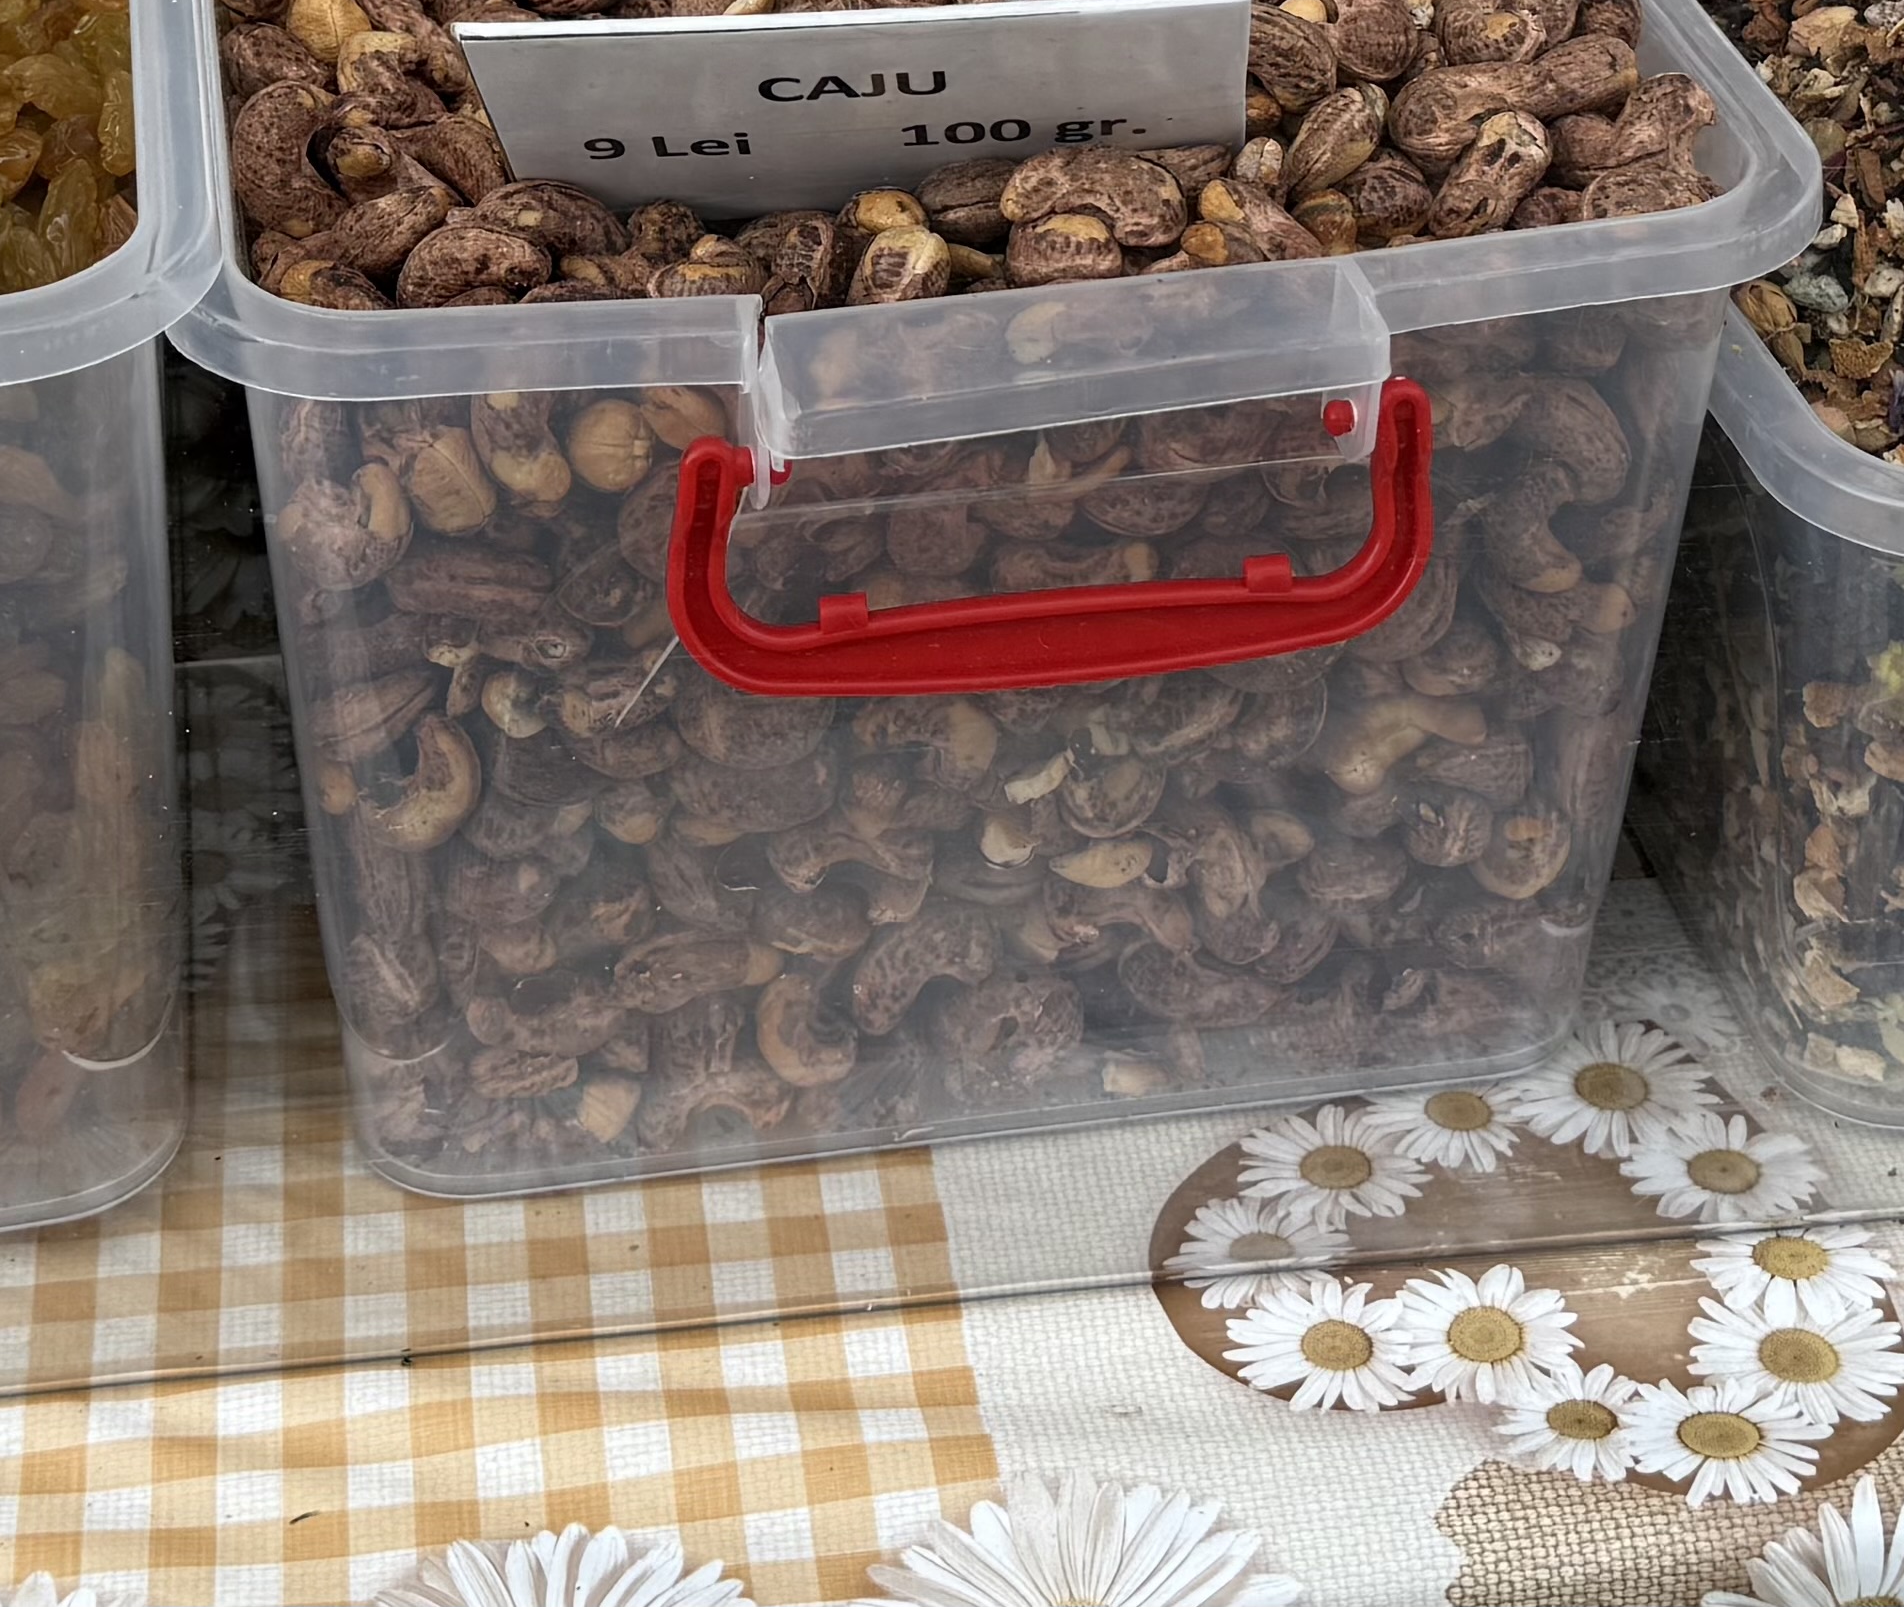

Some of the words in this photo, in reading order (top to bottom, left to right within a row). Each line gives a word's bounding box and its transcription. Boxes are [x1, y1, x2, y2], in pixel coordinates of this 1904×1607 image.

[757, 69, 948, 103] CAJU
[582, 136, 626, 161] 9
[651, 130, 752, 159] Lei
[900, 117, 1032, 148] 100
[1054, 116, 1148, 144] gr.
